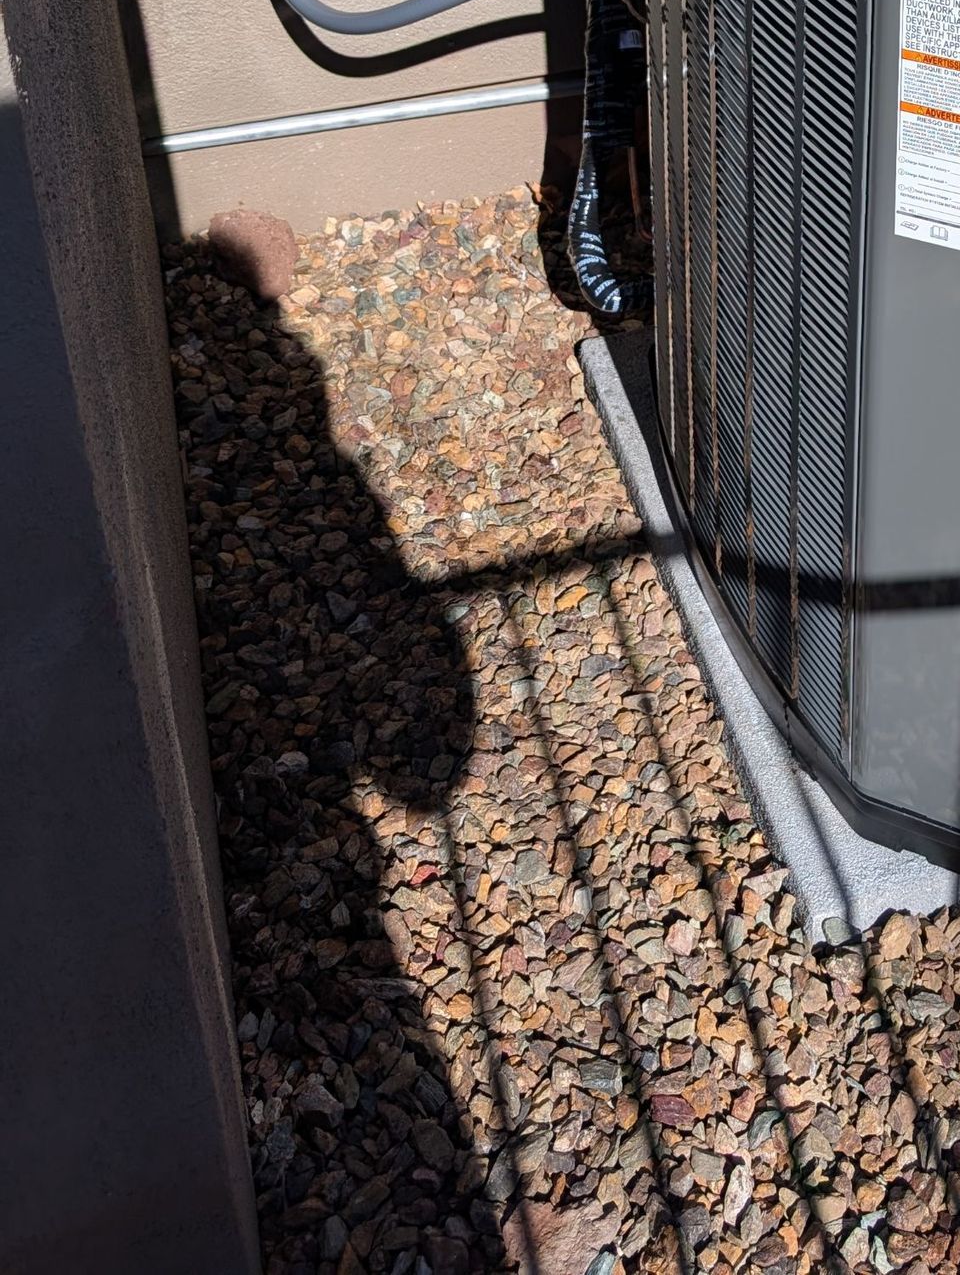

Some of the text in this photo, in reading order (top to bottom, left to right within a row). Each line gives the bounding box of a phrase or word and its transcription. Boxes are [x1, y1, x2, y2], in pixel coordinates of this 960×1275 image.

[953, 0, 960, 8] IN
[906, 7, 927, 18] THAN
[905, 15, 940, 29] DEVICES
[905, 23, 921, 33] USE
[923, 27, 944, 38] WITH
[905, 32, 941, 46] SPECIFIC
[905, 40, 920, 50] SEE
[916, 63, 942, 74] RISQUE
[917, 116, 942, 126] RIESGO
